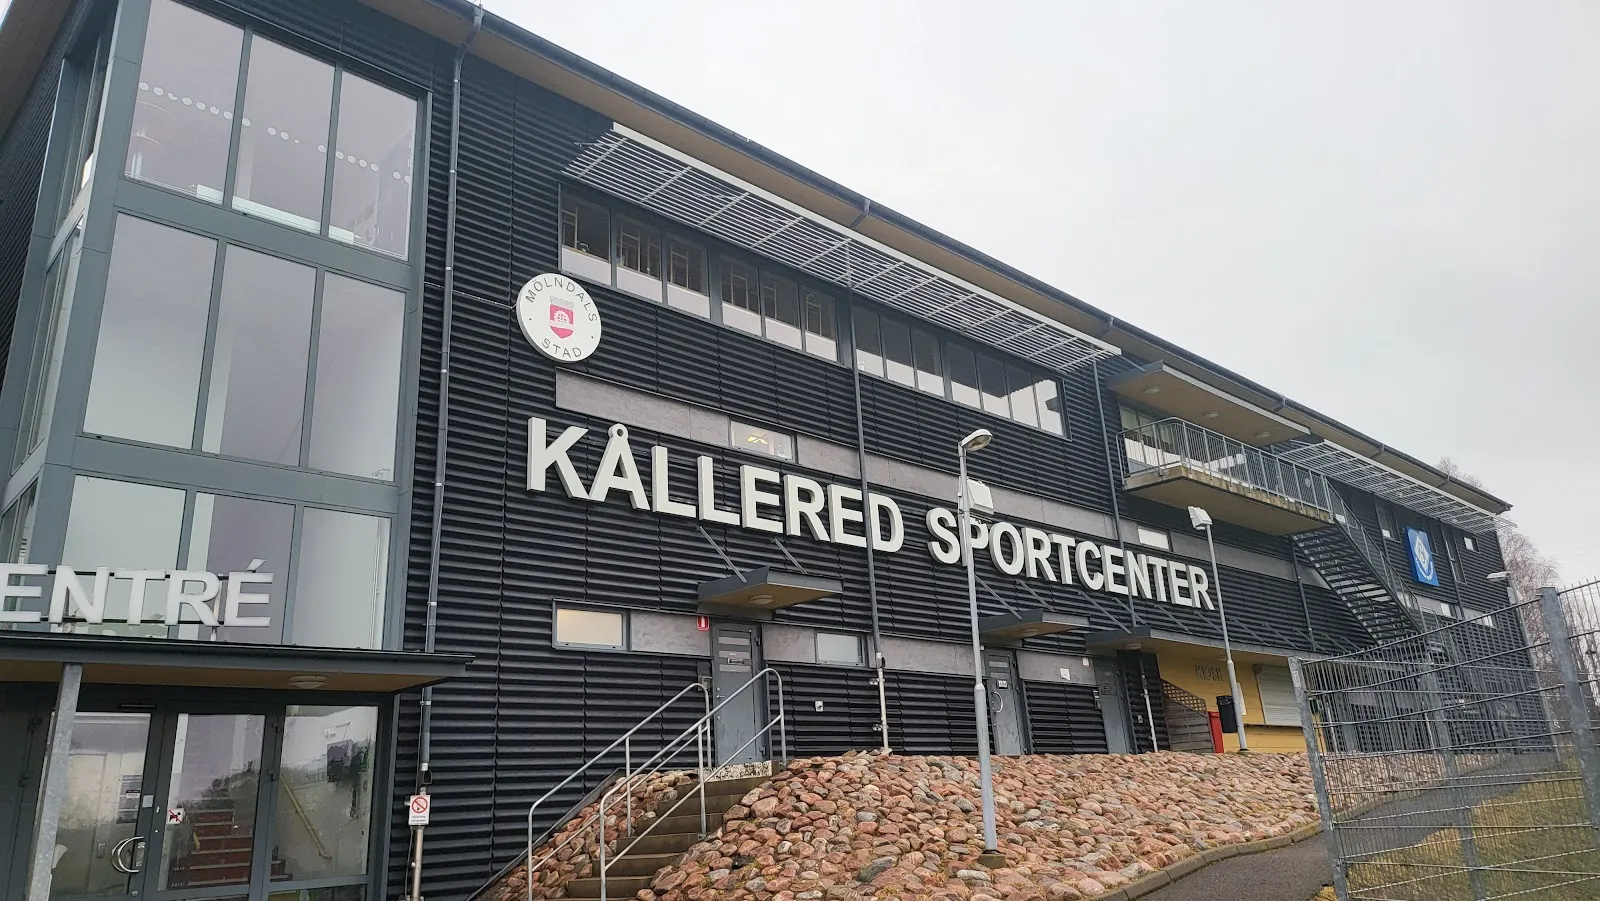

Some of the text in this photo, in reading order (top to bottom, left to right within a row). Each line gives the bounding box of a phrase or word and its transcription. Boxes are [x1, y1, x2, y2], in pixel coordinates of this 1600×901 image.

[525, 277, 597, 322] MÖLNDALS
[541, 338, 582, 359] STAD
[526, 416, 1215, 611] KÅLLERED SPORTCENTER
[0, 558, 275, 627] ENTRÉ
[1195, 664, 1224, 682] KIOSK
